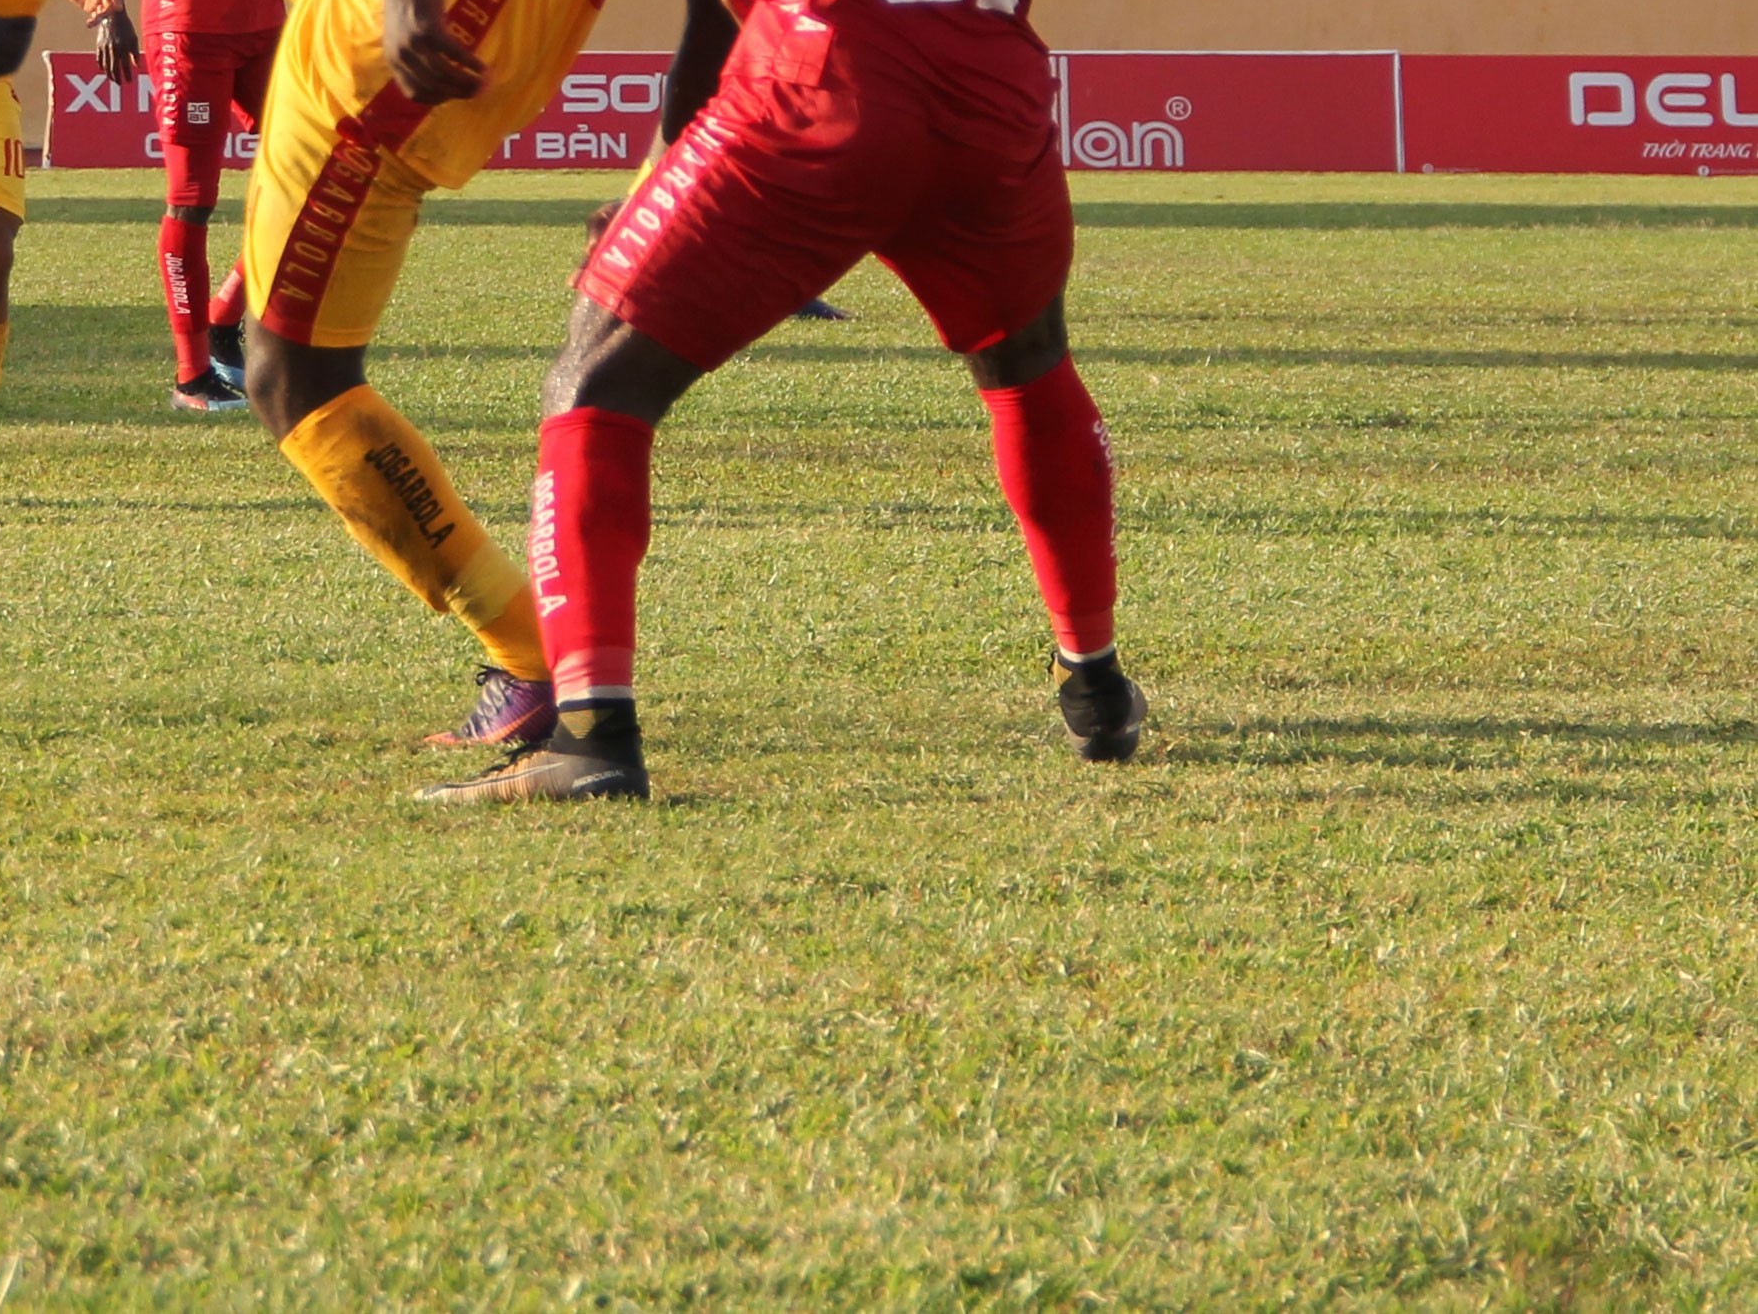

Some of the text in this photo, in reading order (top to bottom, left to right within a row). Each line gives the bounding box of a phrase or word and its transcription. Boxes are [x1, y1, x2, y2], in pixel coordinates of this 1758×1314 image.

[64, 73, 122, 113] XI
[561, 72, 669, 113] SƠ
[4, 137, 25, 178] 10
[535, 123, 627, 160] BẢN
[1641, 139, 1686, 160] THỜI
[1689, 142, 1751, 160] TRANG
[278, 139, 375, 302] OGARBOLA
[164, 252, 191, 315] JOGARBOLA
[364, 442, 456, 550] JOGARBOLA
